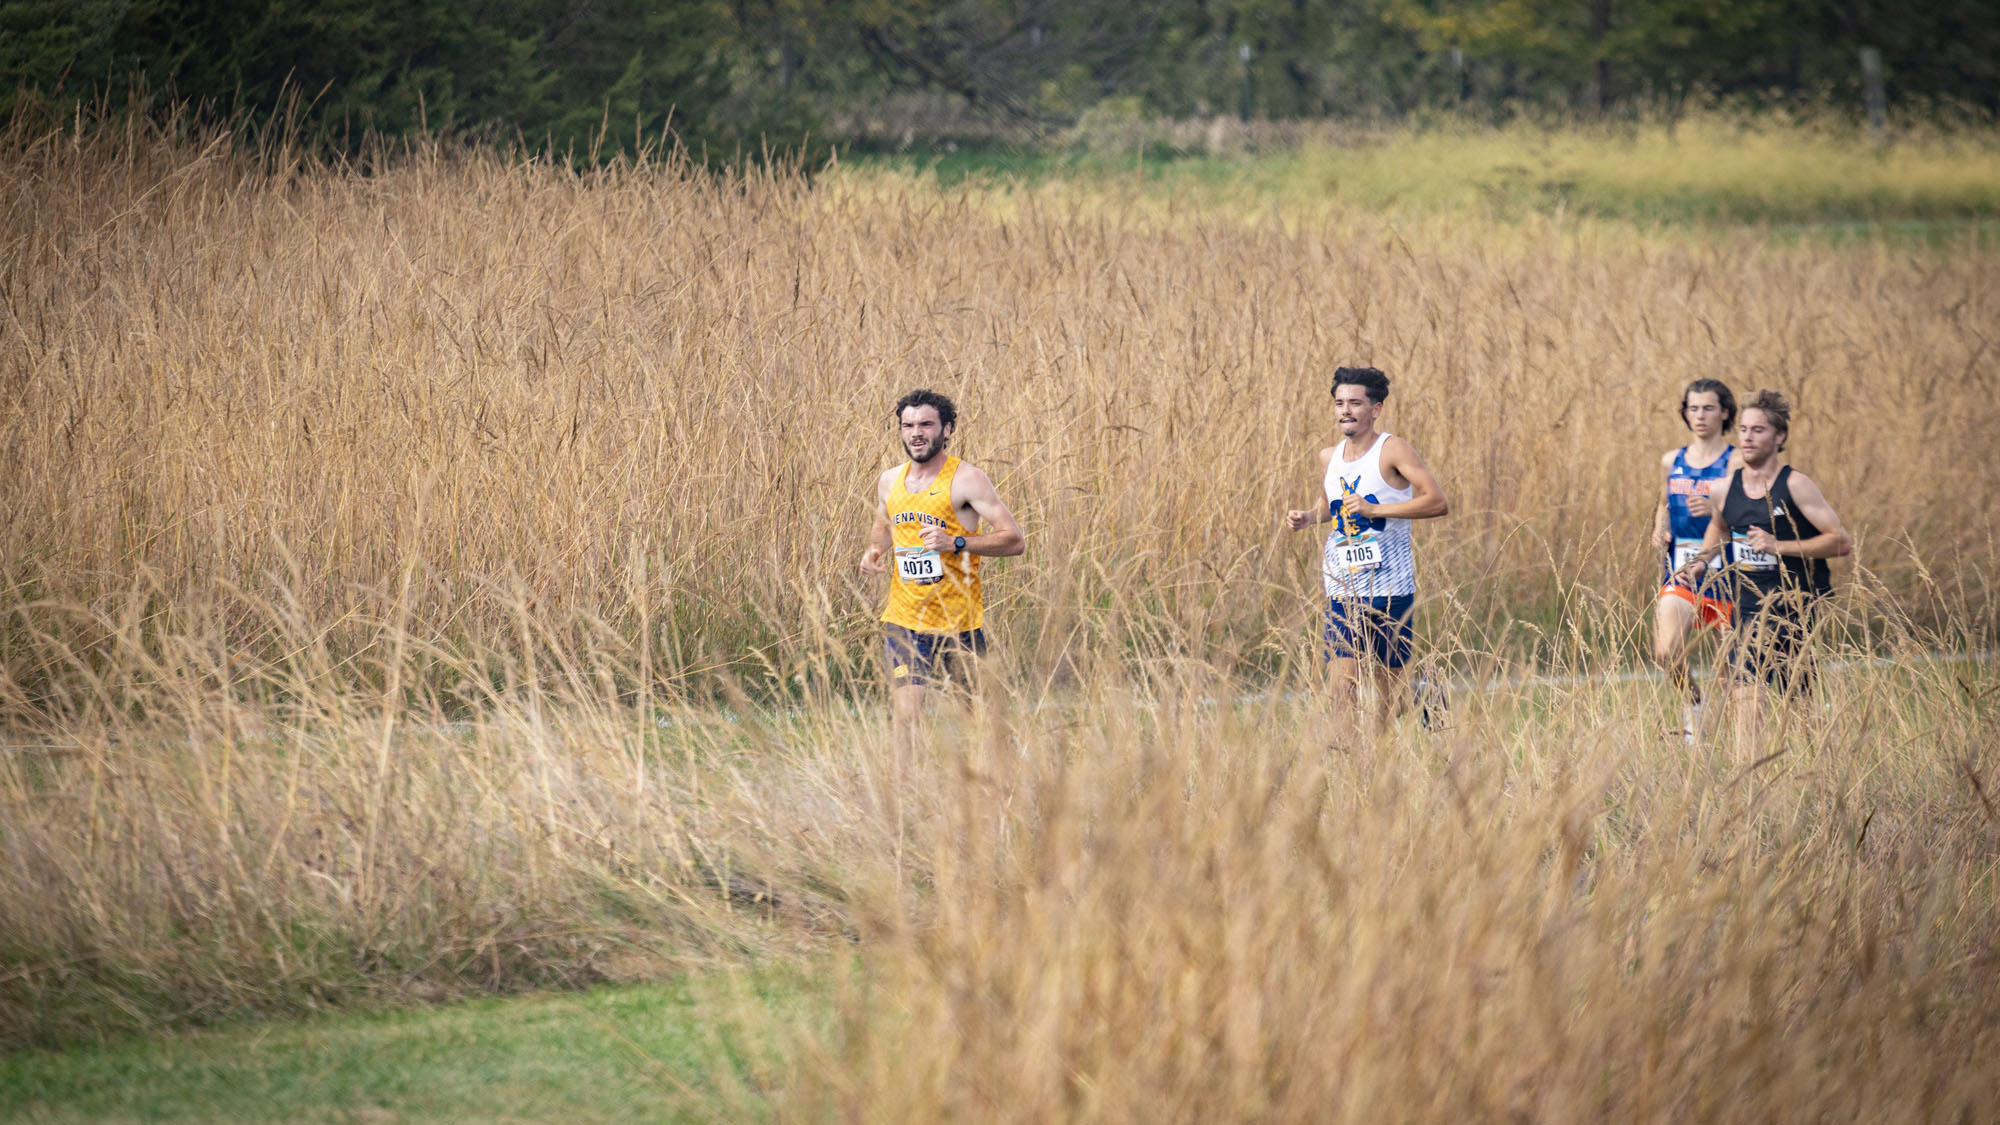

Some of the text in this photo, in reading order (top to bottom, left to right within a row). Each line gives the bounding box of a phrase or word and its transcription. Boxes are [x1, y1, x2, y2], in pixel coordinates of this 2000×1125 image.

[917, 512, 947, 530] VISTA
[1346, 546, 1373, 562] 4105
[903, 559, 933, 575] 4073
